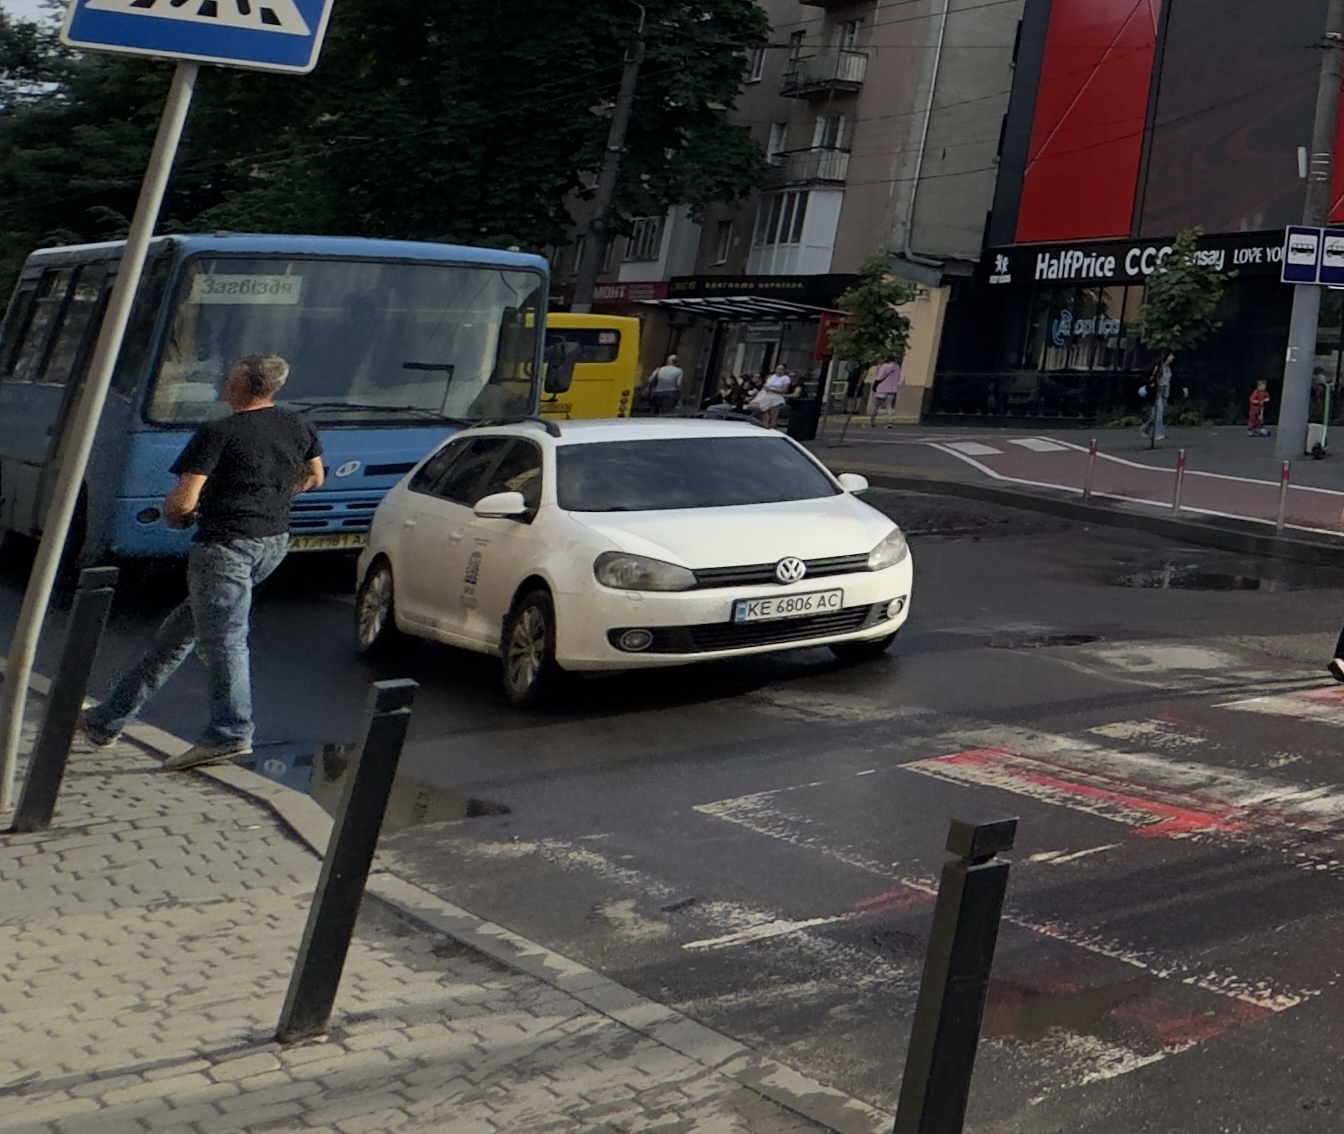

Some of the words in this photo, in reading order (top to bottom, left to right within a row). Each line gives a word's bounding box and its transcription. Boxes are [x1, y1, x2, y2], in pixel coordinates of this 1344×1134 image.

[1035, 250, 1116, 280] HalfPrice
[1233, 247, 1263, 264] LOVE
[593, 285, 626, 299] МОНТ
[747, 601, 772, 617] KE
[776, 596, 814, 614] 6806
[816, 593, 839, 609] AC
